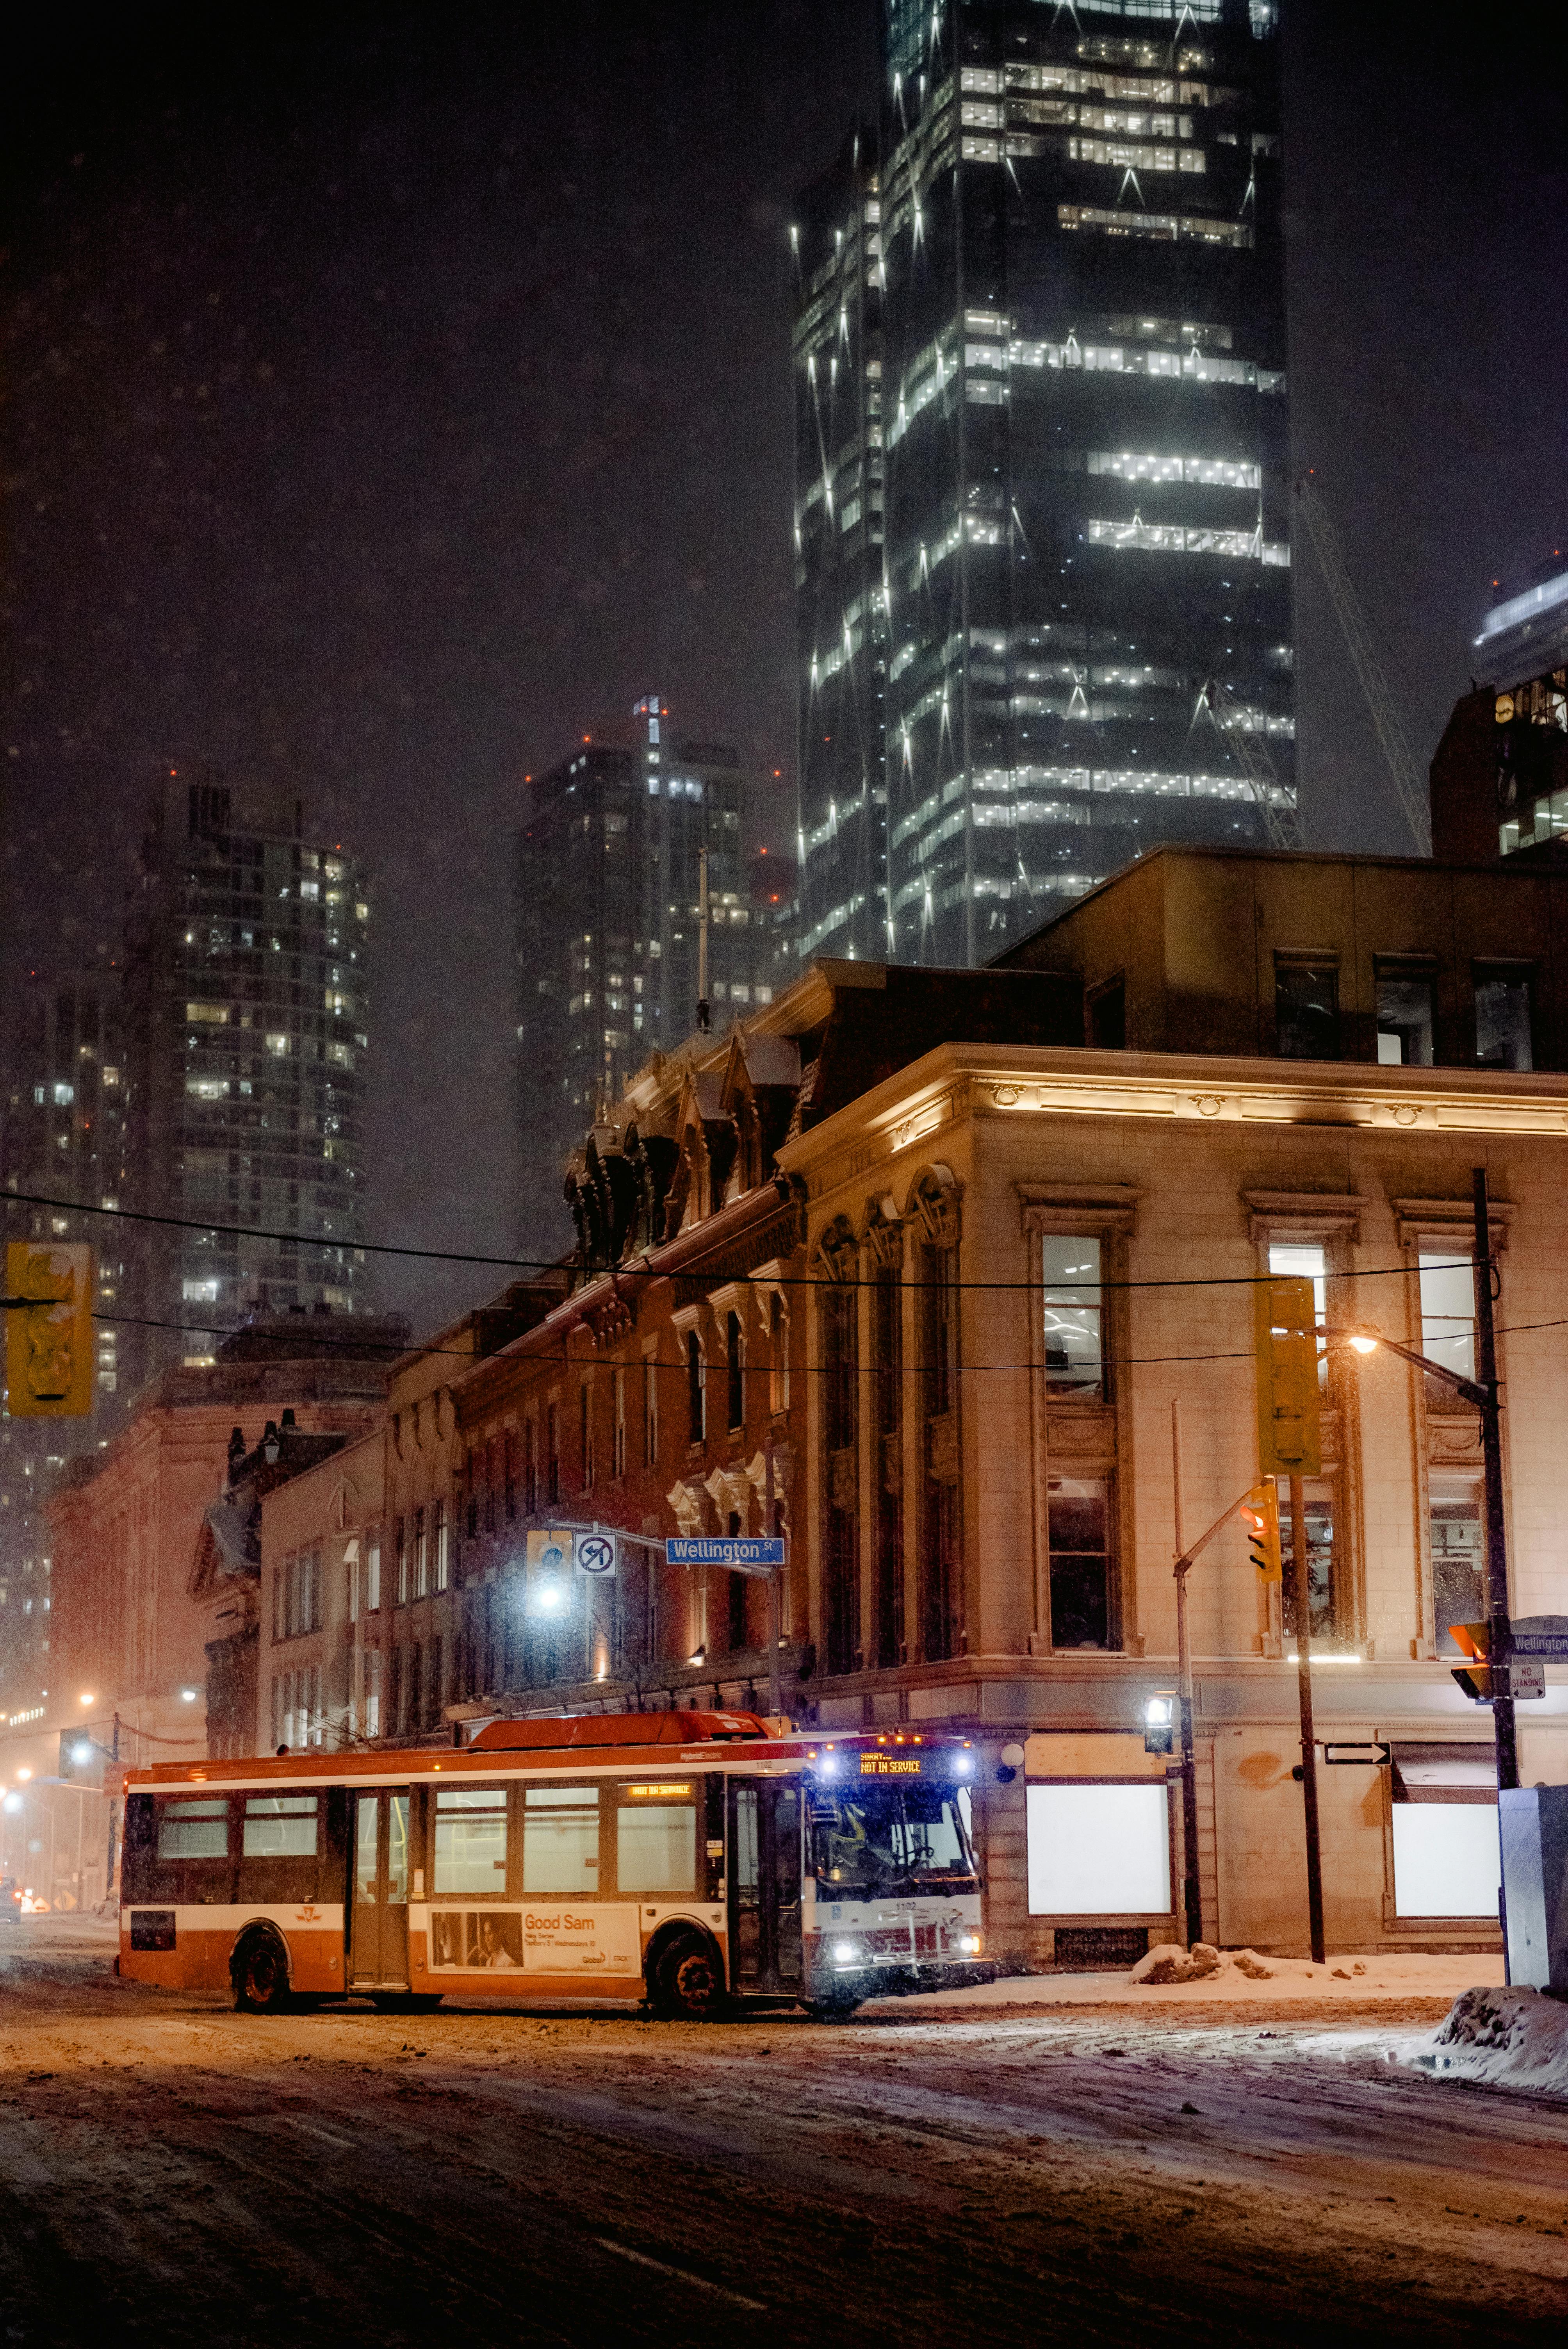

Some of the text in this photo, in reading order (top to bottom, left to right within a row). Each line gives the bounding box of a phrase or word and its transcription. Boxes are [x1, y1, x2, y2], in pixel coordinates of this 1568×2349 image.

[674, 1541, 773, 1562] Wellington St
[1515, 1636, 1568, 1653] Wellington
[1521, 1667, 1532, 1676] NO
[1511, 1679, 1543, 1687] STANDING
[861, 1761, 921, 1773] NOT IN SERVICE
[632, 1785, 690, 1795] NOT IN SERVICE
[525, 1914, 594, 1930] Good Sam
